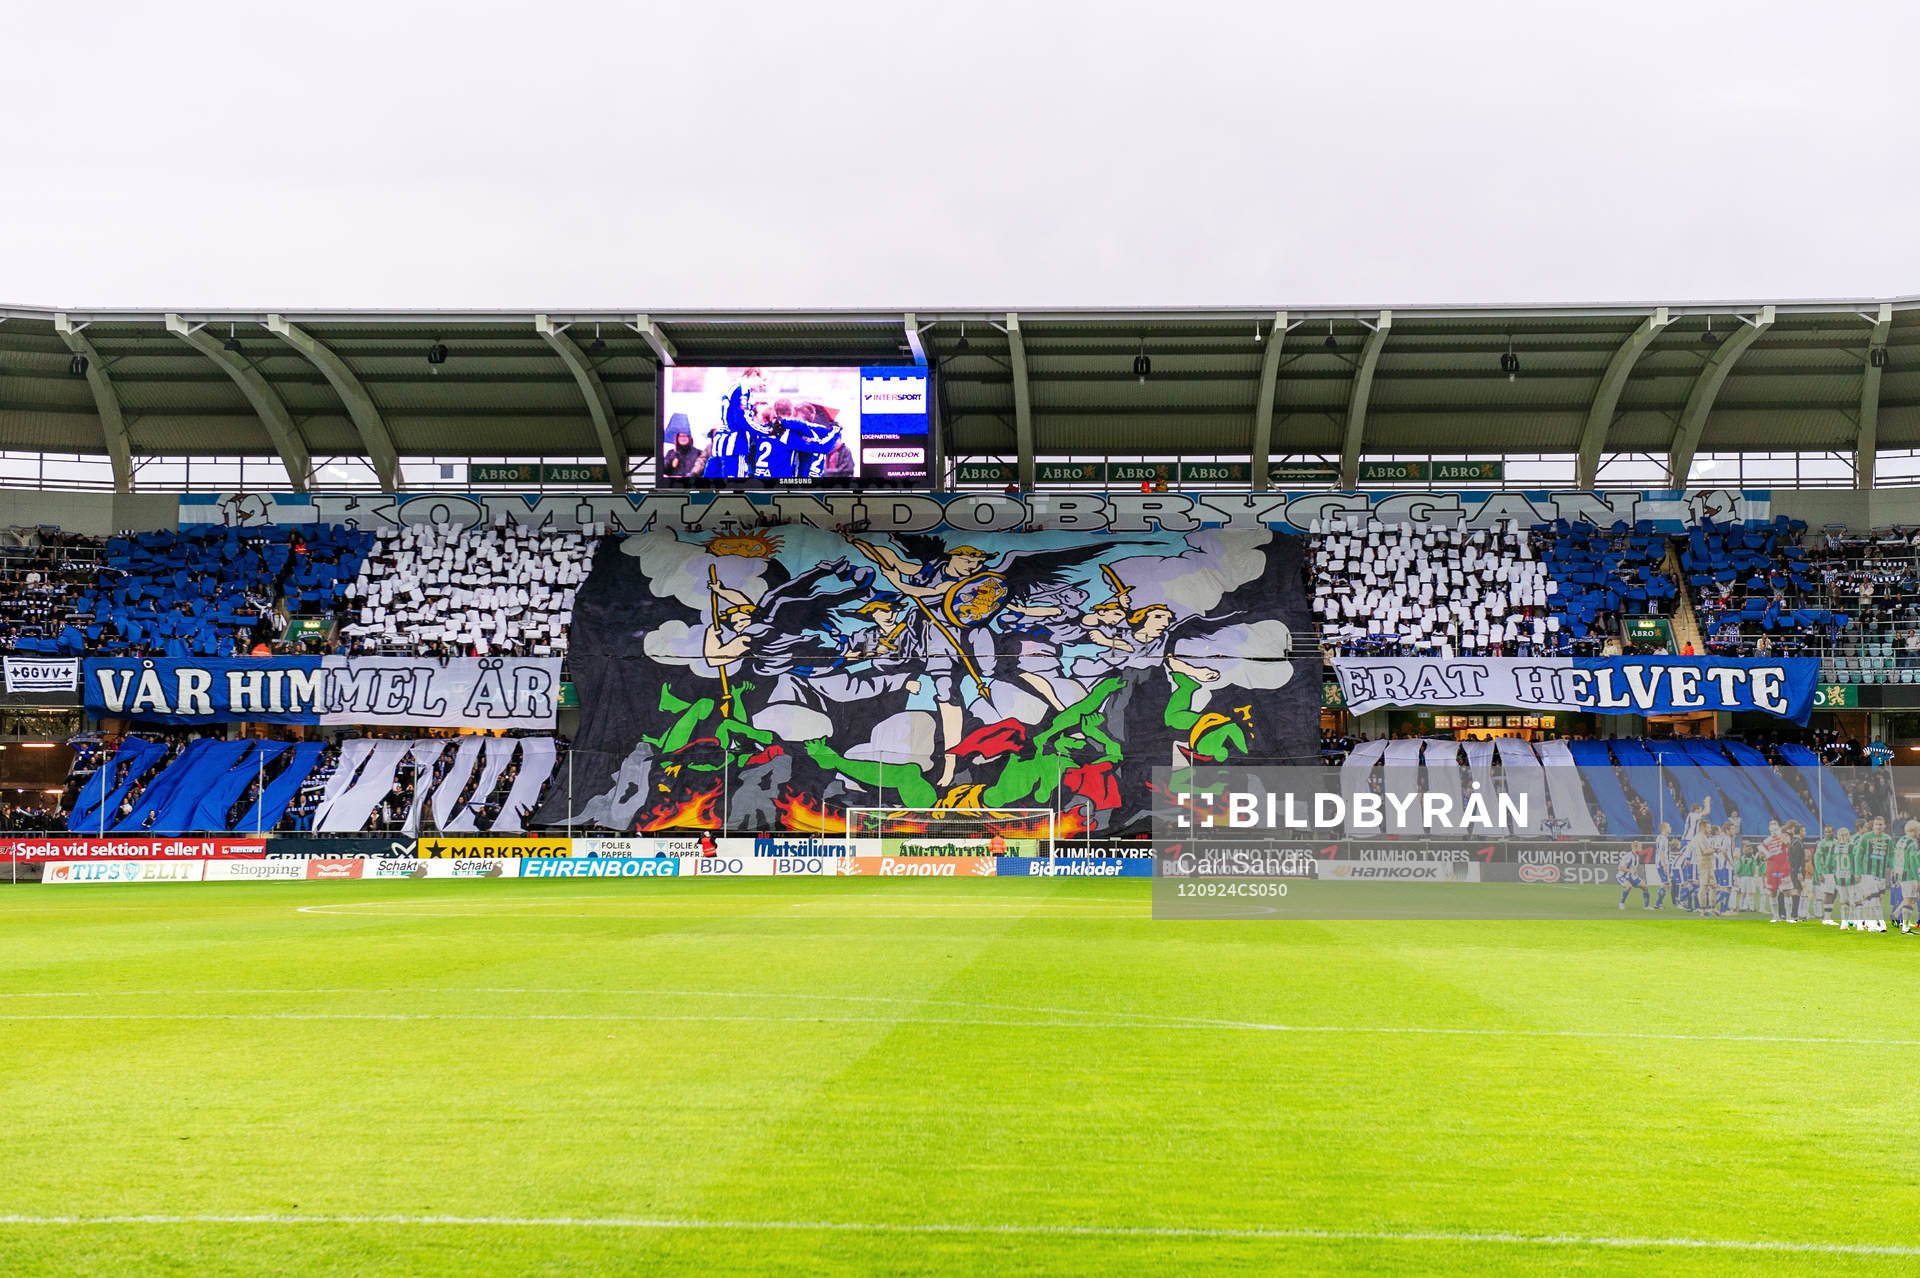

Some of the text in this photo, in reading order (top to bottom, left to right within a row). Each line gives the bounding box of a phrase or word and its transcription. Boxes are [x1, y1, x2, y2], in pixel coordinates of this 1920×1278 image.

[756, 441, 772, 467] 2
[479, 468, 519, 480] ÅBRO
[551, 468, 591, 480] ÅBRO
[960, 467, 1000, 479] ÅBRO
[1043, 467, 1082, 479] ÅBRO
[1116, 467, 1156, 479] ÅBRO
[1188, 467, 1229, 479] ÅBRO
[1366, 465, 1406, 477] ÅBRO
[1439, 465, 1480, 477] ÅBRO
[311, 493, 1642, 533] KOMMANDOBRYGGAN
[21, 667, 61, 678] GGVV
[96, 658, 553, 719] VÅR HIMMEL ÄR
[1337, 664, 1788, 715] ERAT HELVETE
[17, 842, 60, 859] Spela
[63, 842, 88, 856] vid
[91, 842, 149, 856] sektion
[152, 842, 162, 856] F
[164, 842, 200, 856] eller
[202, 842, 215, 856] N
[451, 847, 568, 858] MARKBYGG
[1053, 848, 1157, 859] KUMHO TYRES
[1360, 850, 1470, 862] KUMHO TYRES
[1517, 851, 1627, 864] KUMHO TYRES
[1834, 853, 1851, 870] 10
[72, 864, 121, 880] TIPS
[143, 863, 194, 879] ELIT
[230, 864, 301, 877] Shopping
[378, 861, 417, 871] Schakt
[453, 860, 493, 871] Schakt
[523, 859, 675, 877] EHRENBORG
[700, 859, 743, 873] BDO
[779, 859, 822, 873] BDO
[879, 858, 956, 876] Renova
[1029, 861, 1123, 877] Björnkläder
